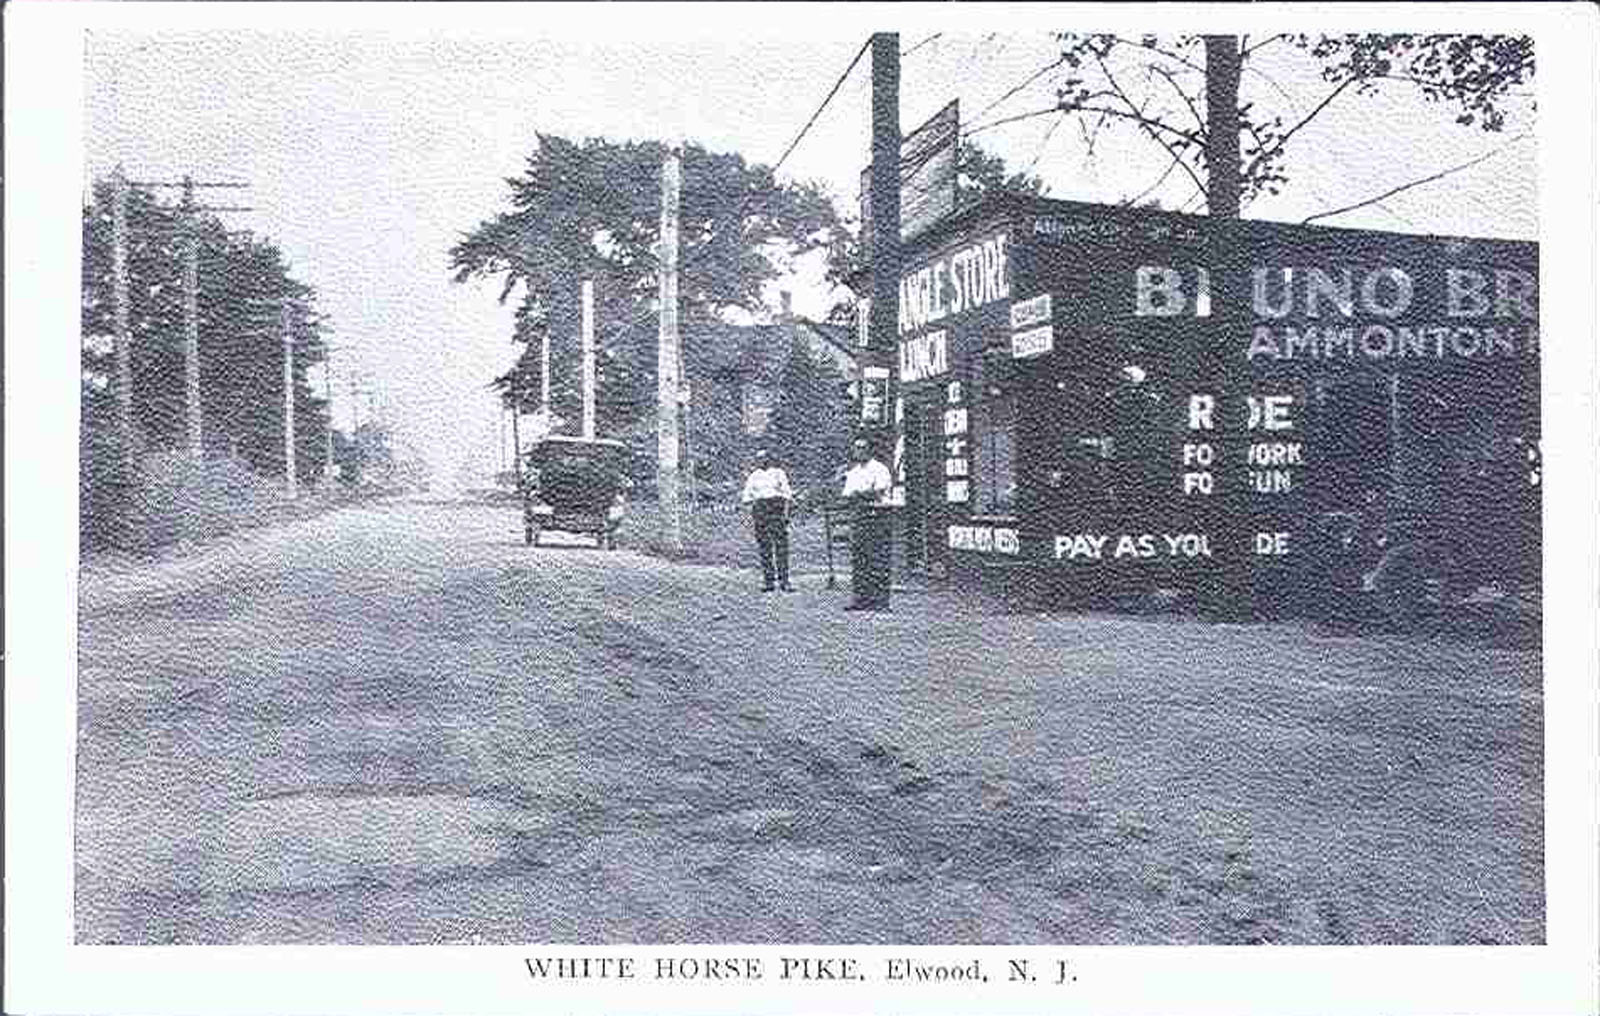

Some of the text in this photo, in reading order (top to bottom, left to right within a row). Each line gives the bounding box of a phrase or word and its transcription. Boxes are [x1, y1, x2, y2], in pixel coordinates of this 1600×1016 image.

[951, 235, 1009, 314] STORE
[1135, 265, 1414, 317] BUNO
[1183, 443, 1213, 466] FO
[1183, 471, 1213, 495] FO
[1054, 535, 1107, 559] PAY
[1114, 534, 1155, 558] AS
